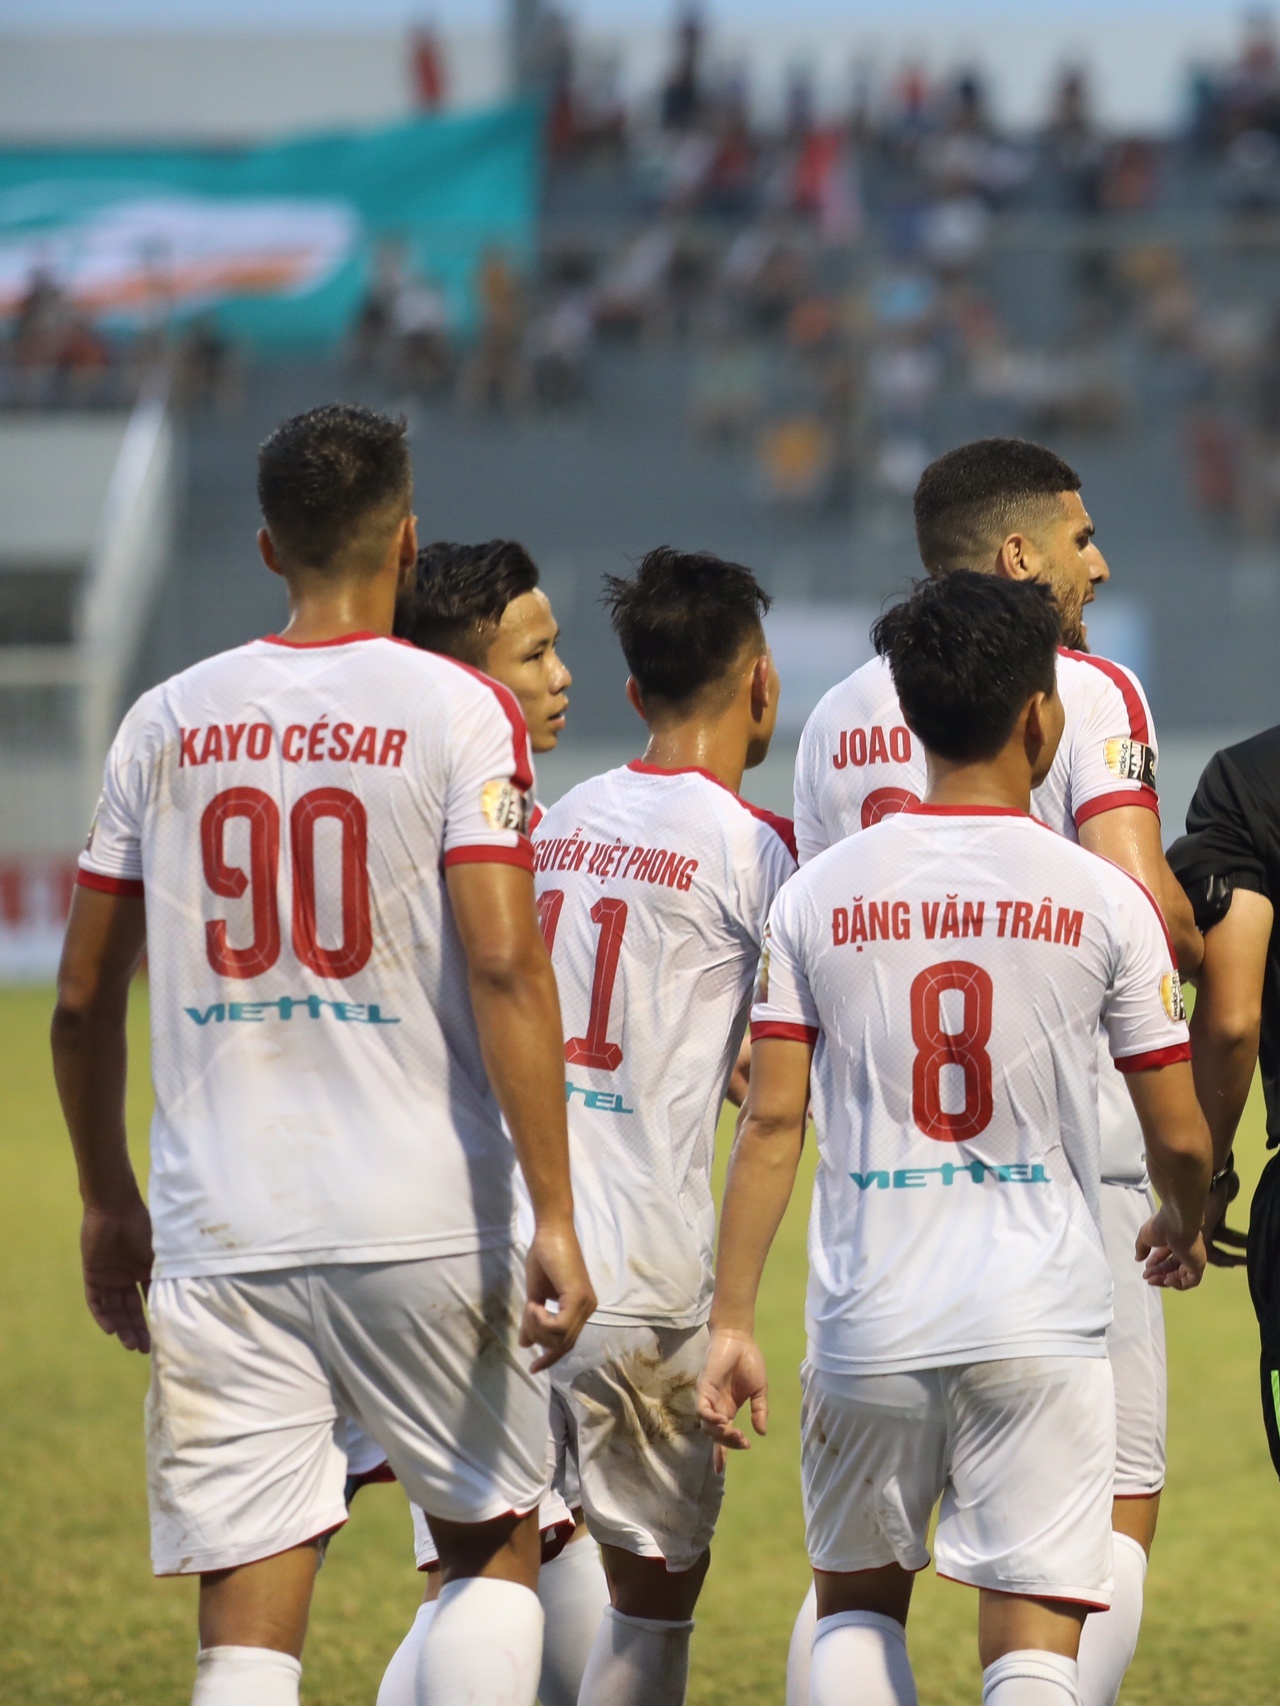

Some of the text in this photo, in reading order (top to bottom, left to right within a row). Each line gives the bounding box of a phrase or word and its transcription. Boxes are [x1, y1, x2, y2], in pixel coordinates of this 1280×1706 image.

[179, 713, 407, 768] KAYO CÉSAR
[832, 725, 911, 770] JOAO
[200, 786, 373, 980] 90
[531, 827, 592, 873] GUYỄN
[622, 844, 699, 892] PHONG
[831, 893, 1085, 952] ĐẶNG VĂN TRÂM
[184, 994, 401, 1026] VIETTEL
[909, 960, 993, 1142] 8
[849, 1160, 1051, 1191] VIETTEL
